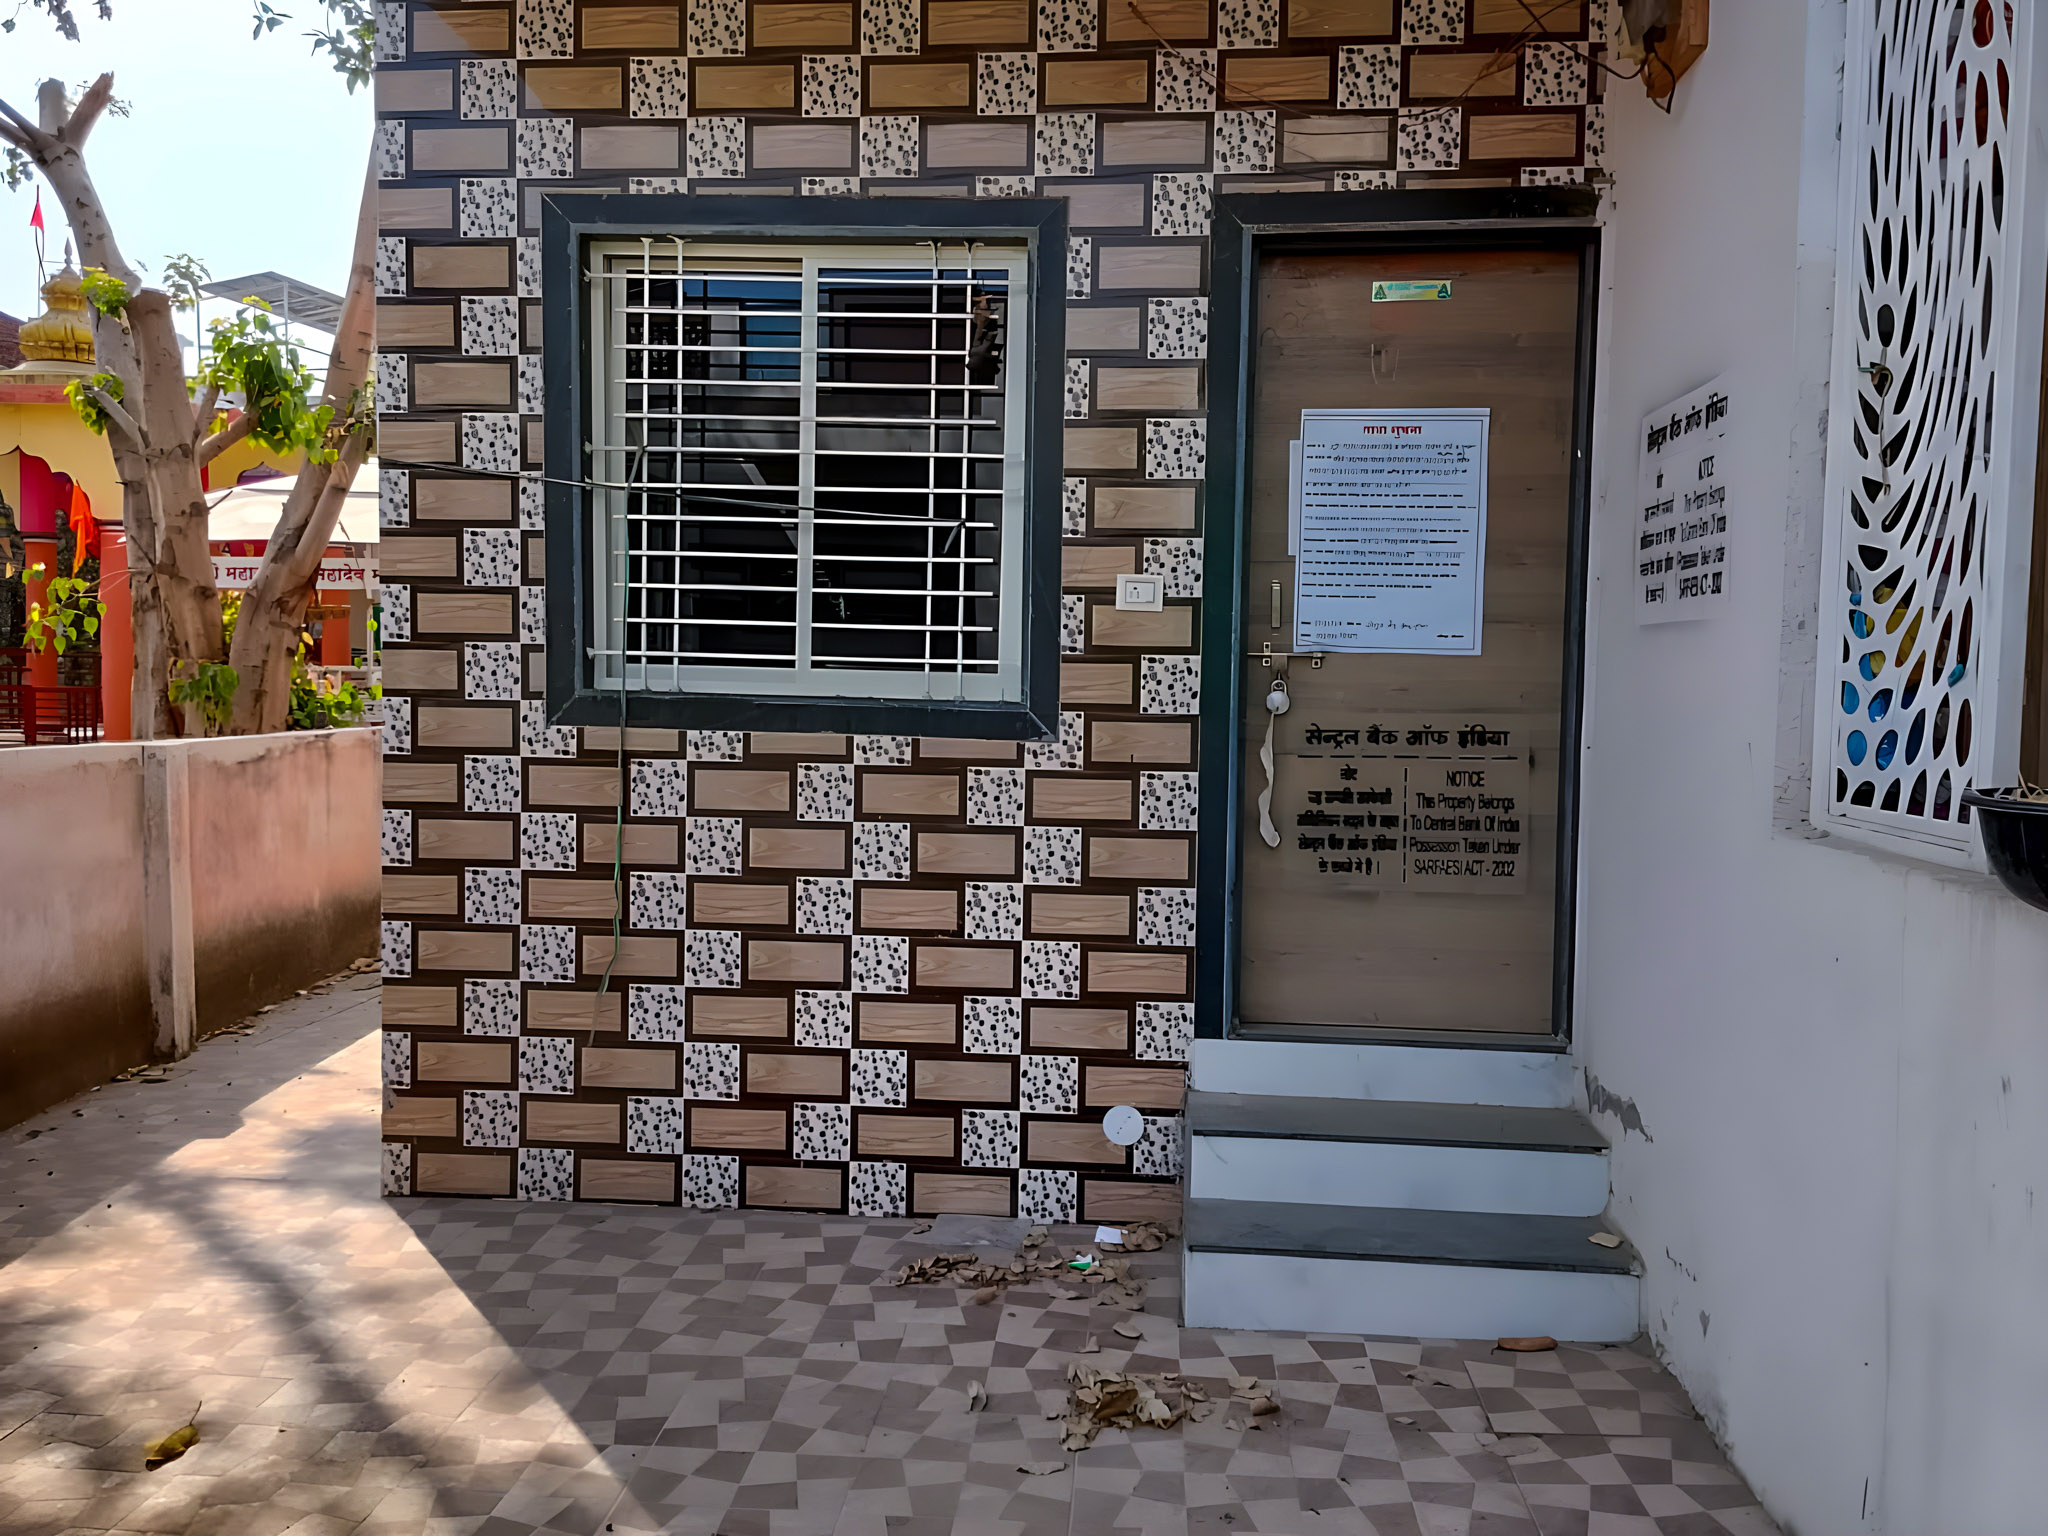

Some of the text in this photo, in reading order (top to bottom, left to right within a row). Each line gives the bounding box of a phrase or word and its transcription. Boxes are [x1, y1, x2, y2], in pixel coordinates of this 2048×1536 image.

[1305, 723, 1360, 749] सेन्ट्रल
[1366, 723, 1399, 745] बैंक
[1446, 770, 1485, 787] NOTICE
[1416, 793, 1435, 809] This
[1438, 793, 1475, 813] Property
[1478, 794, 1515, 814] Belongs
[1410, 815, 1422, 830] To
[1424, 815, 1456, 831] Central
[1459, 816, 1481, 831] Bank
[1493, 838, 1520, 854] Under
[1464, 860, 1485, 876] ACT
